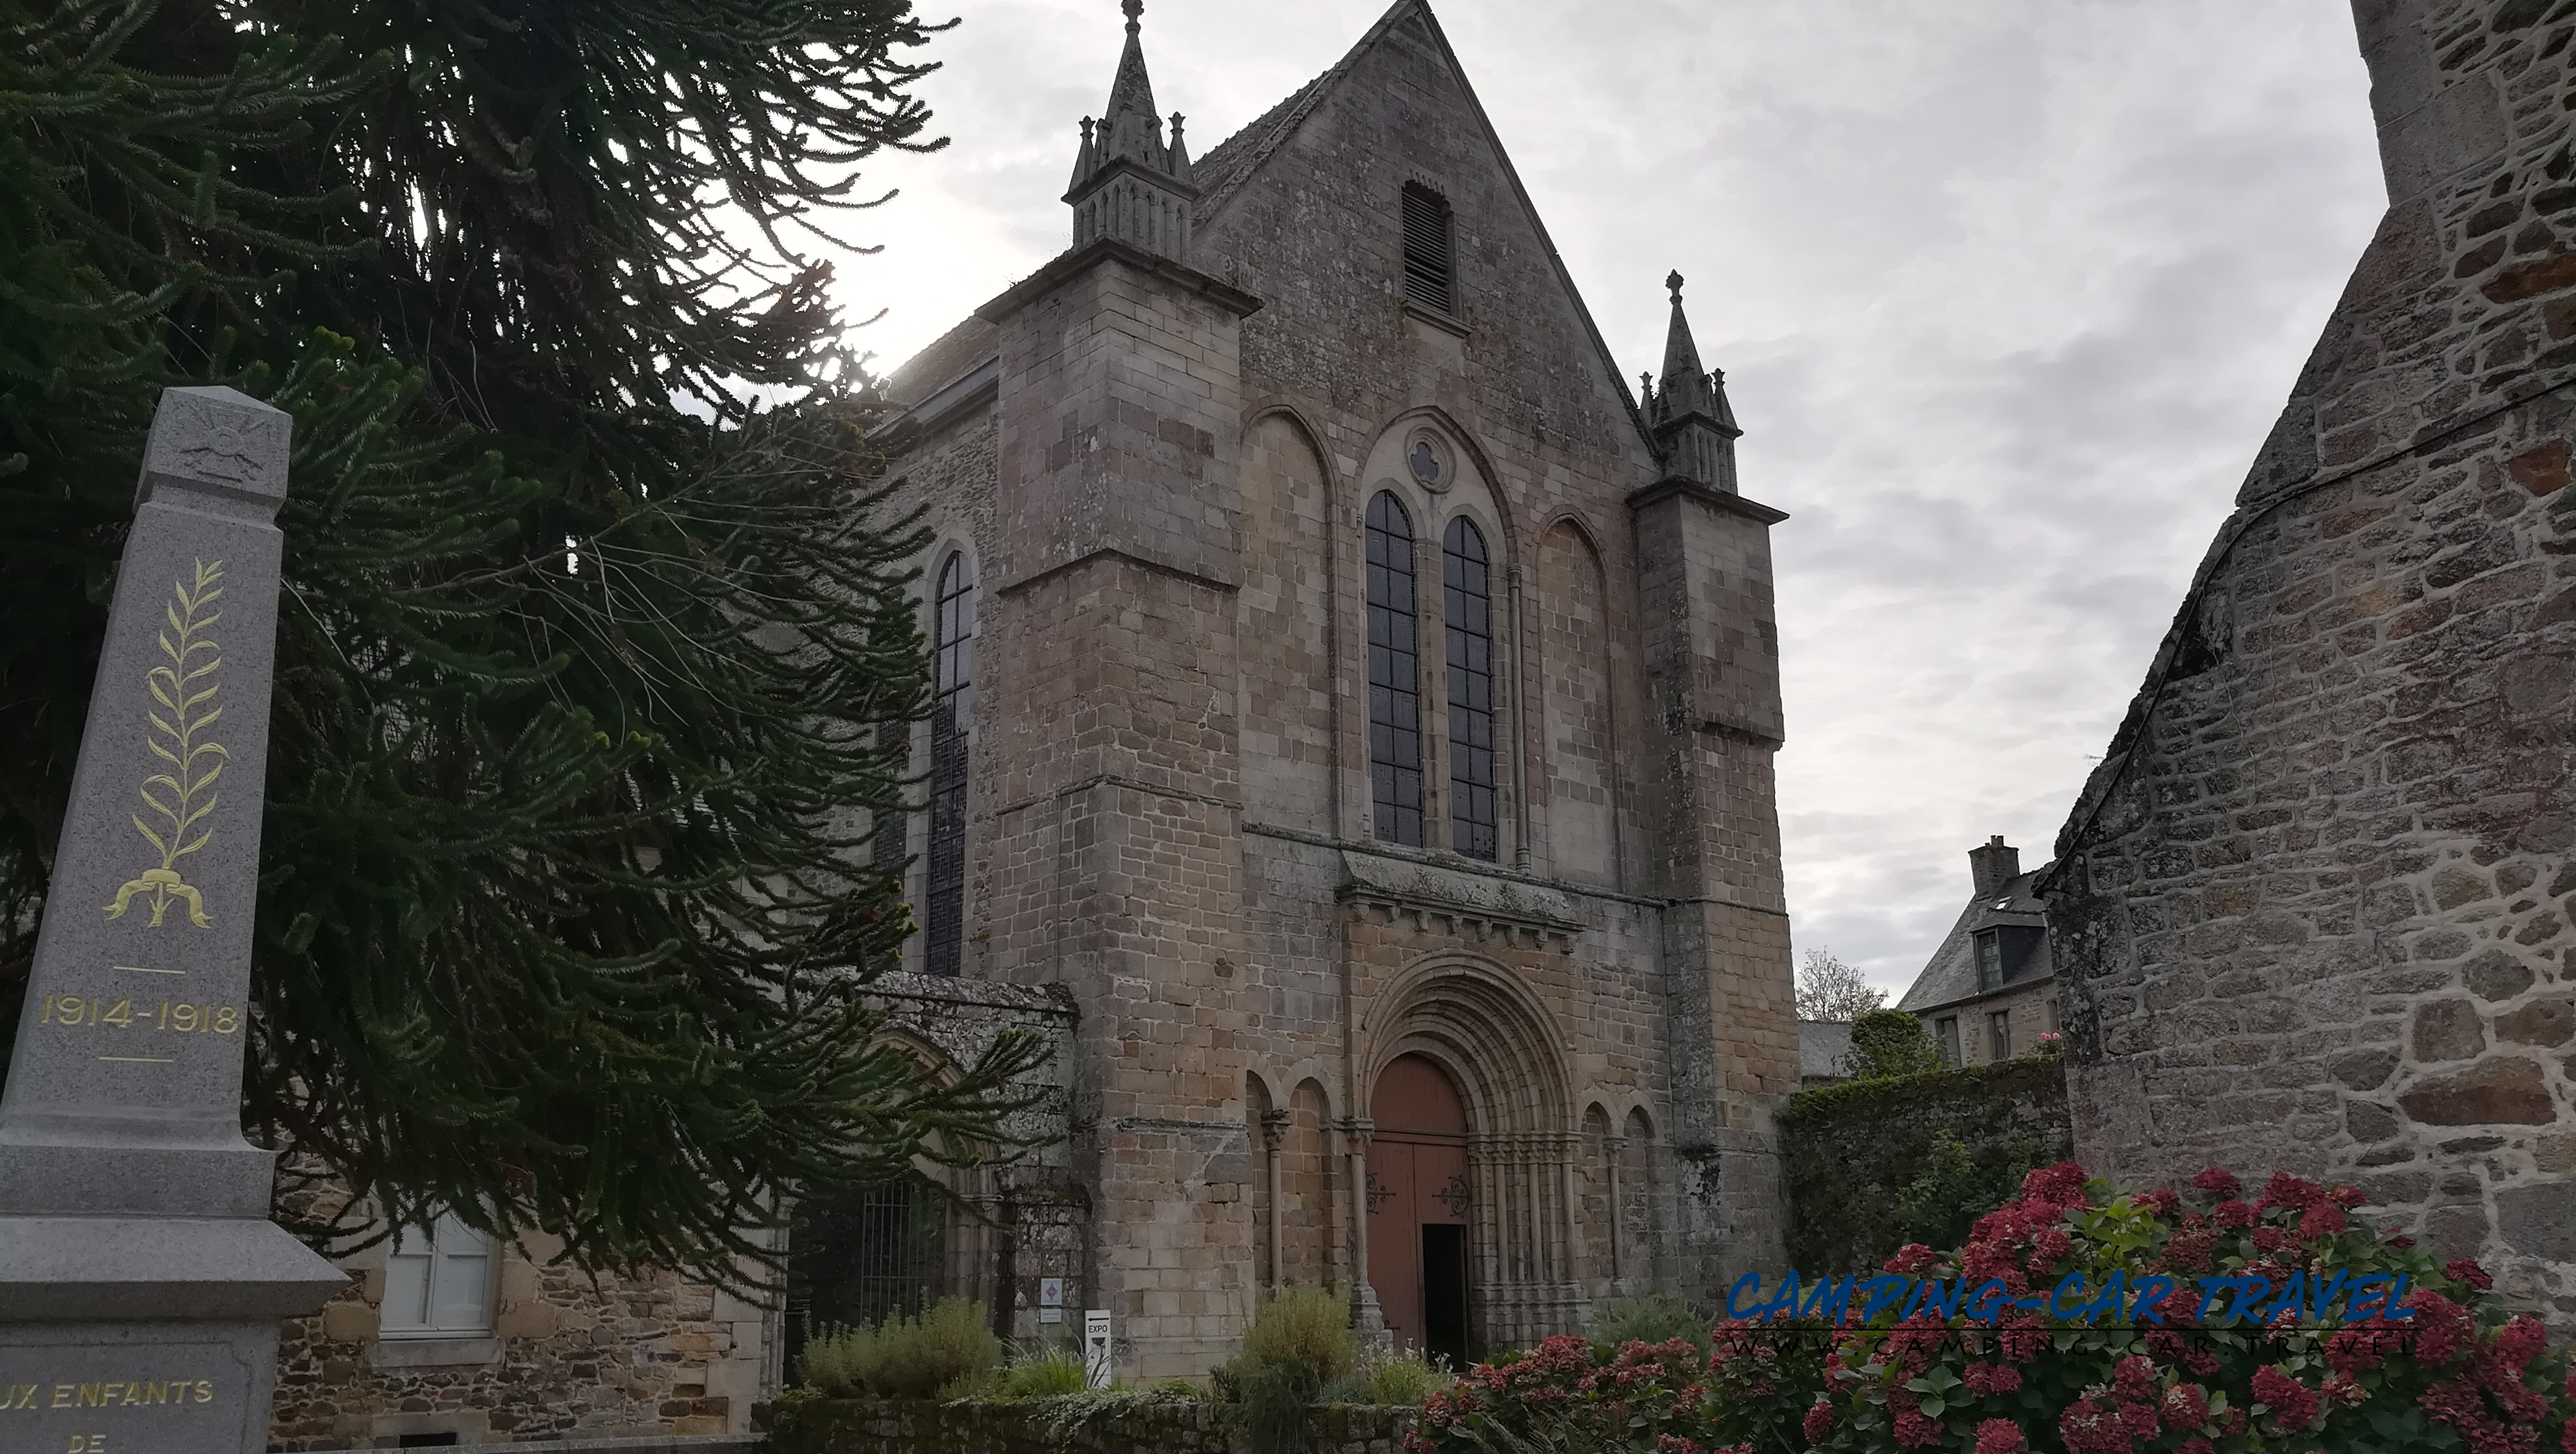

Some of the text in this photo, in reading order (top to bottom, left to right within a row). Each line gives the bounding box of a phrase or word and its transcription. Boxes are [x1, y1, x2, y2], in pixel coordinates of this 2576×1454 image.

[41, 994, 238, 1033] 1914-1918
[51, 1381, 214, 1408] ENFANTS
[68, 1434, 106, 1454] DE
